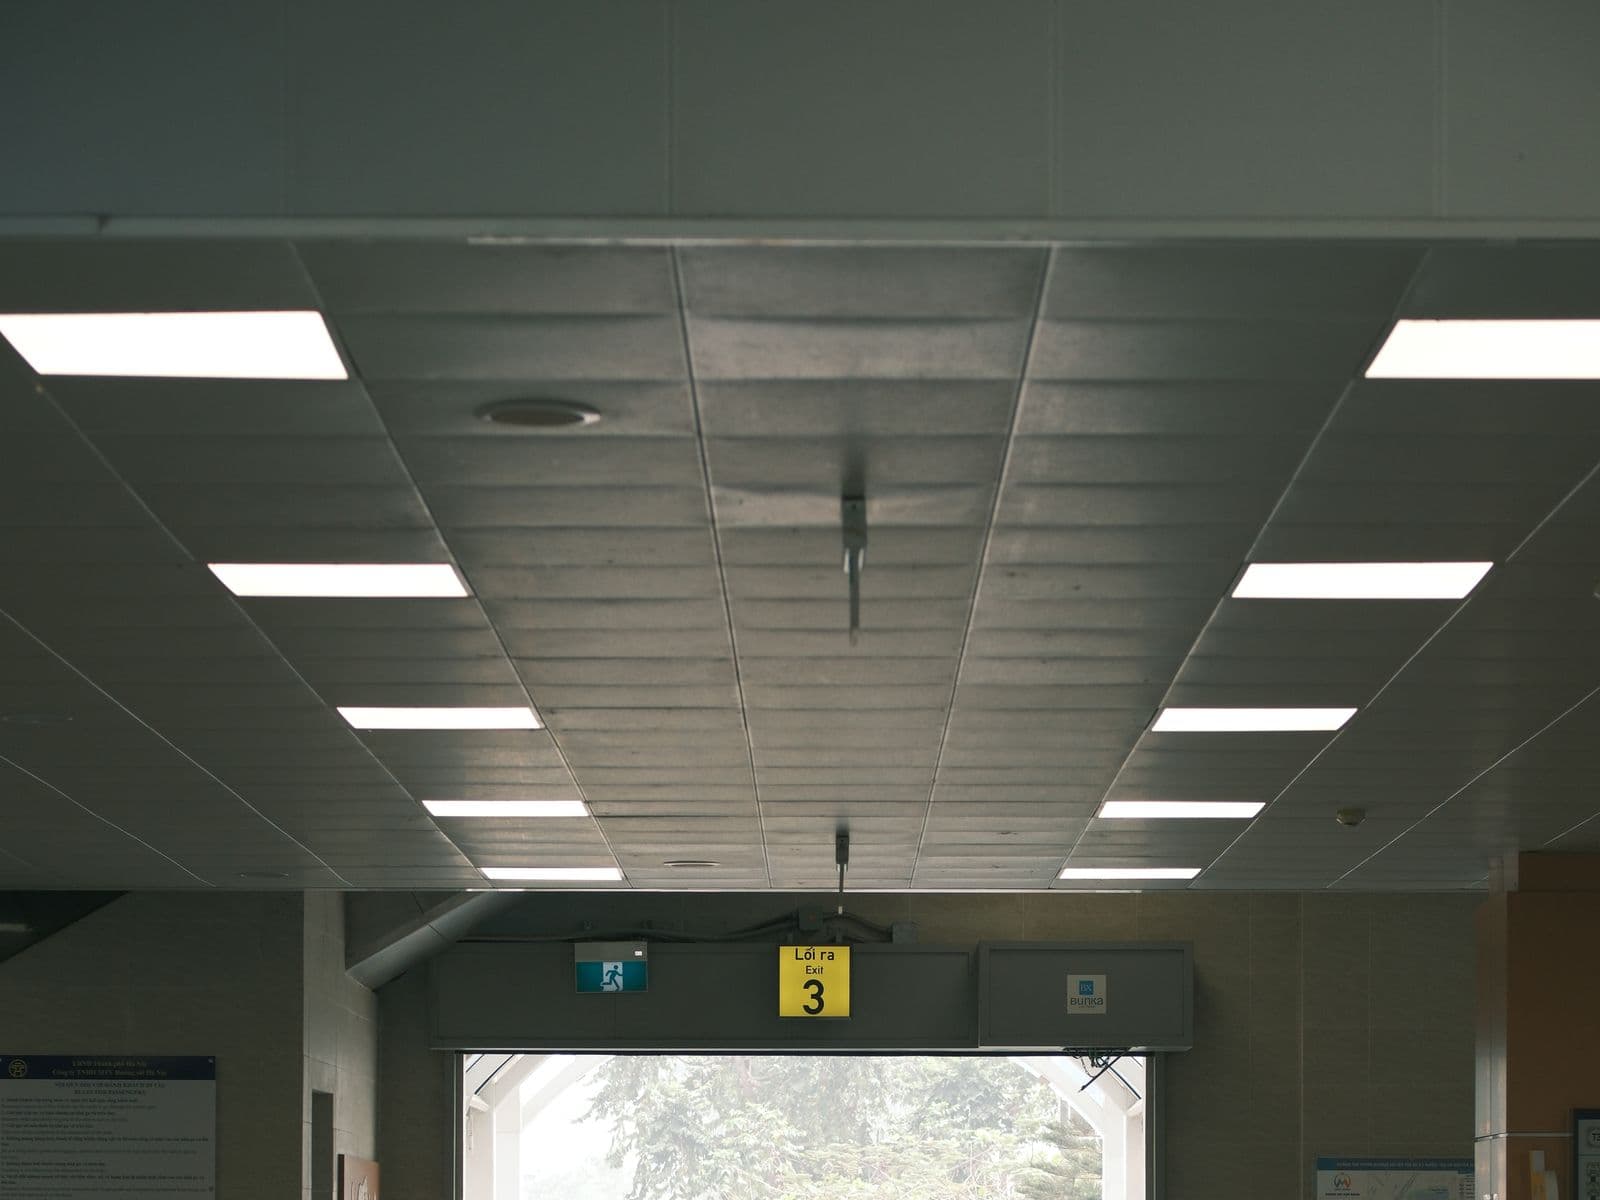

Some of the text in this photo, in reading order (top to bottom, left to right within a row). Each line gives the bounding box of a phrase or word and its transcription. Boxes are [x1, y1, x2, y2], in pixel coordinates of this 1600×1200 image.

[820, 951, 835, 960] ra
[805, 965, 824, 974] Exit
[803, 979, 825, 1015] 3
